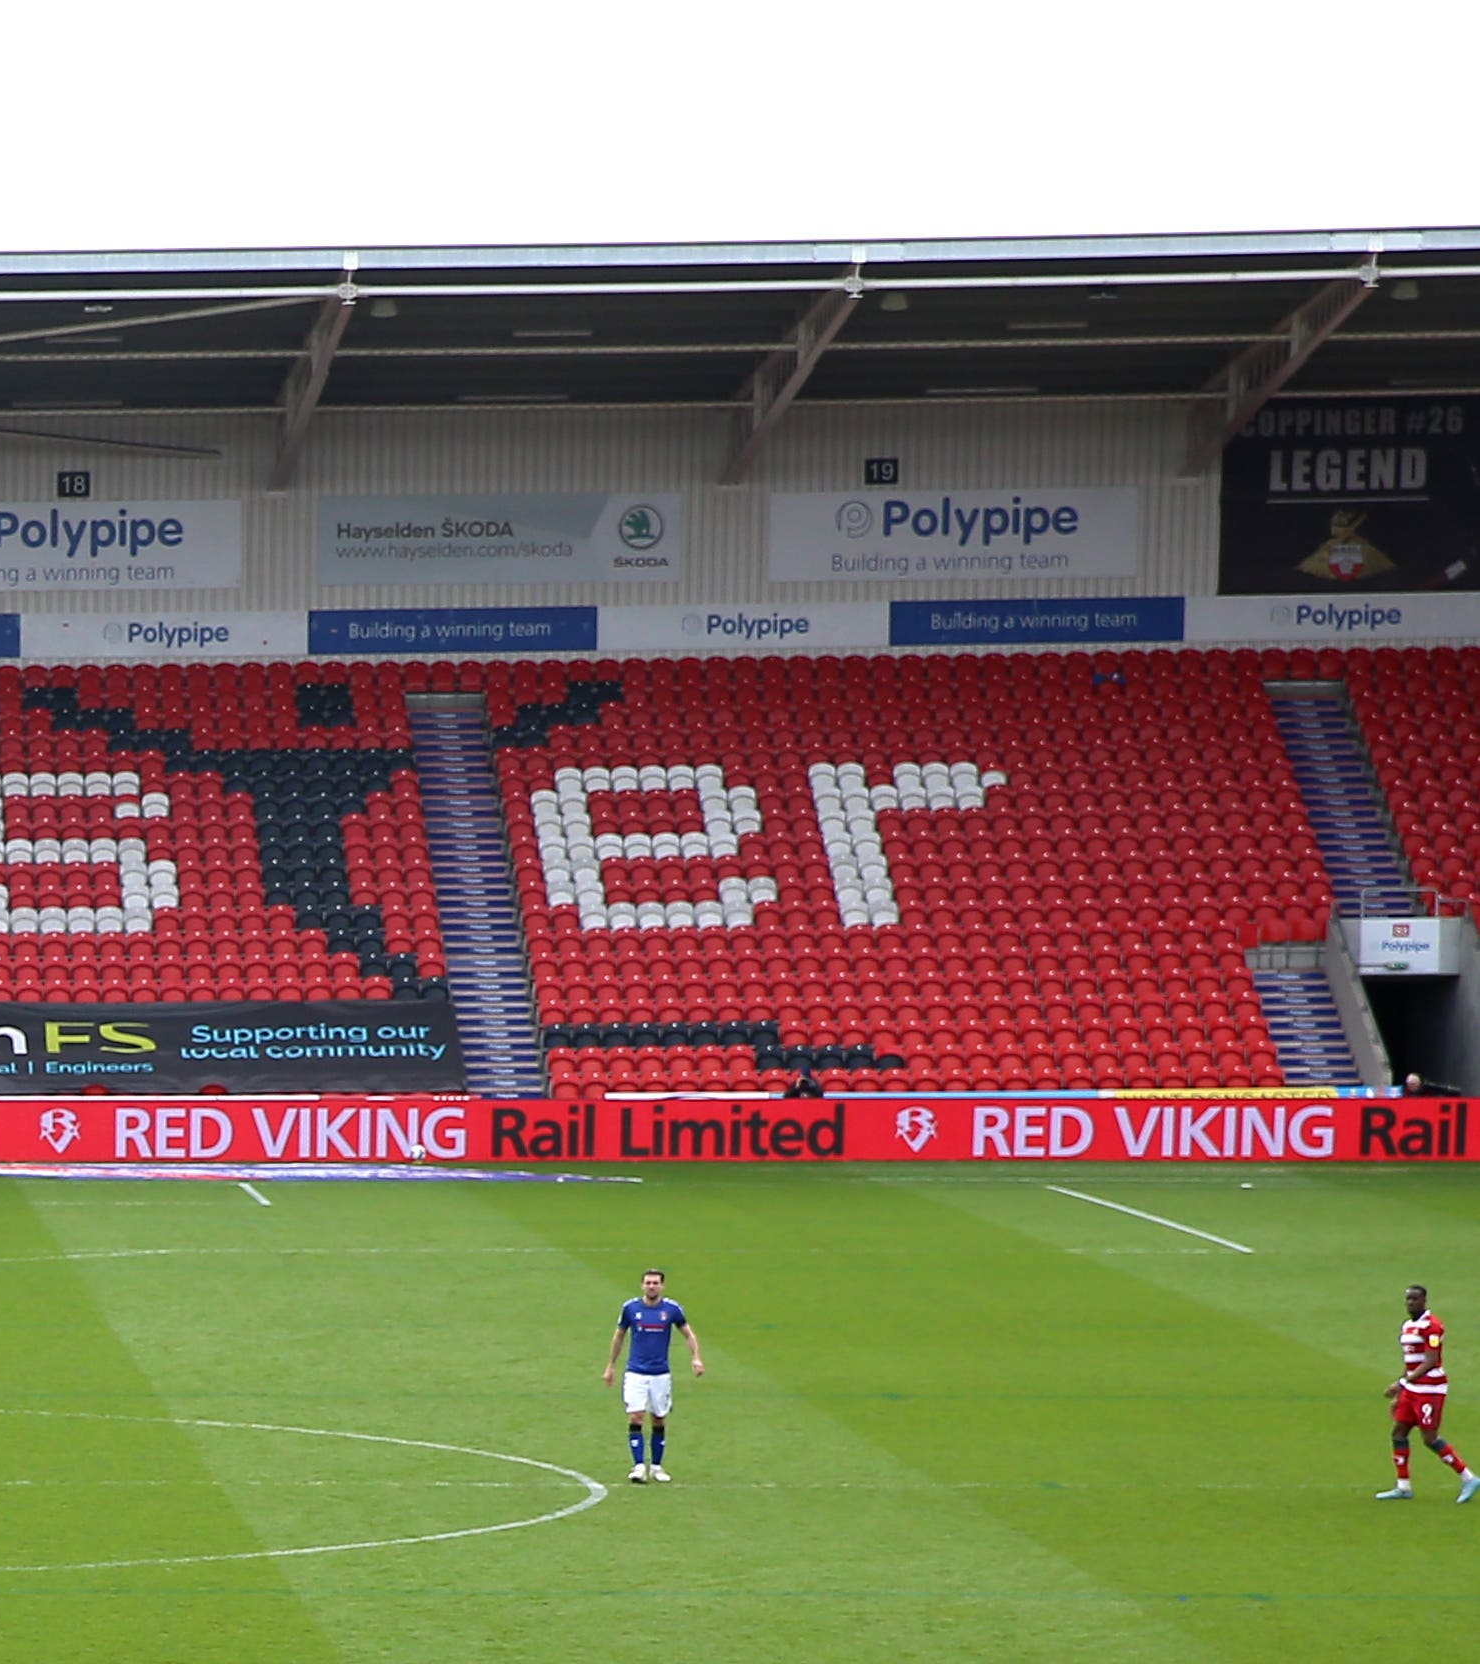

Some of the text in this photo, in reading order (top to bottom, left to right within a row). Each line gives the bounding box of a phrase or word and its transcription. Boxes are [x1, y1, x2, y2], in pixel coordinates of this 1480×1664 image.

[1406, 405, 1464, 435] #26
[870, 463, 894, 481] 19
[1268, 446, 1428, 493] LEGEND
[61, 476, 86, 494] 18
[336, 516, 514, 544] Hayselden ŠKODA
[881, 496, 1079, 546] Polypipe
[25, 568, 37, 583] a
[43, 565, 120, 586] winning
[126, 564, 175, 582] team
[831, 551, 1069, 574] Building a winning team
[347, 620, 417, 641] Building
[436, 621, 506, 641] winning
[510, 620, 552, 637] team
[706, 613, 810, 640] Polypipe
[929, 610, 1000, 634] Building
[1018, 610, 1089, 632] winning
[1094, 609, 1138, 629] team
[1295, 603, 1403, 631] Polypipe
[127, 621, 230, 648] Polypipe
[45, 1020, 157, 1055] FS
[190, 1022, 430, 1045] Supporting our
[266, 1040, 446, 1062] community
[45, 1060, 153, 1076] Engineers
[114, 1104, 843, 1159] RED VIKING Rail Limited
[972, 1103, 1468, 1158] RED VIKING Rail
